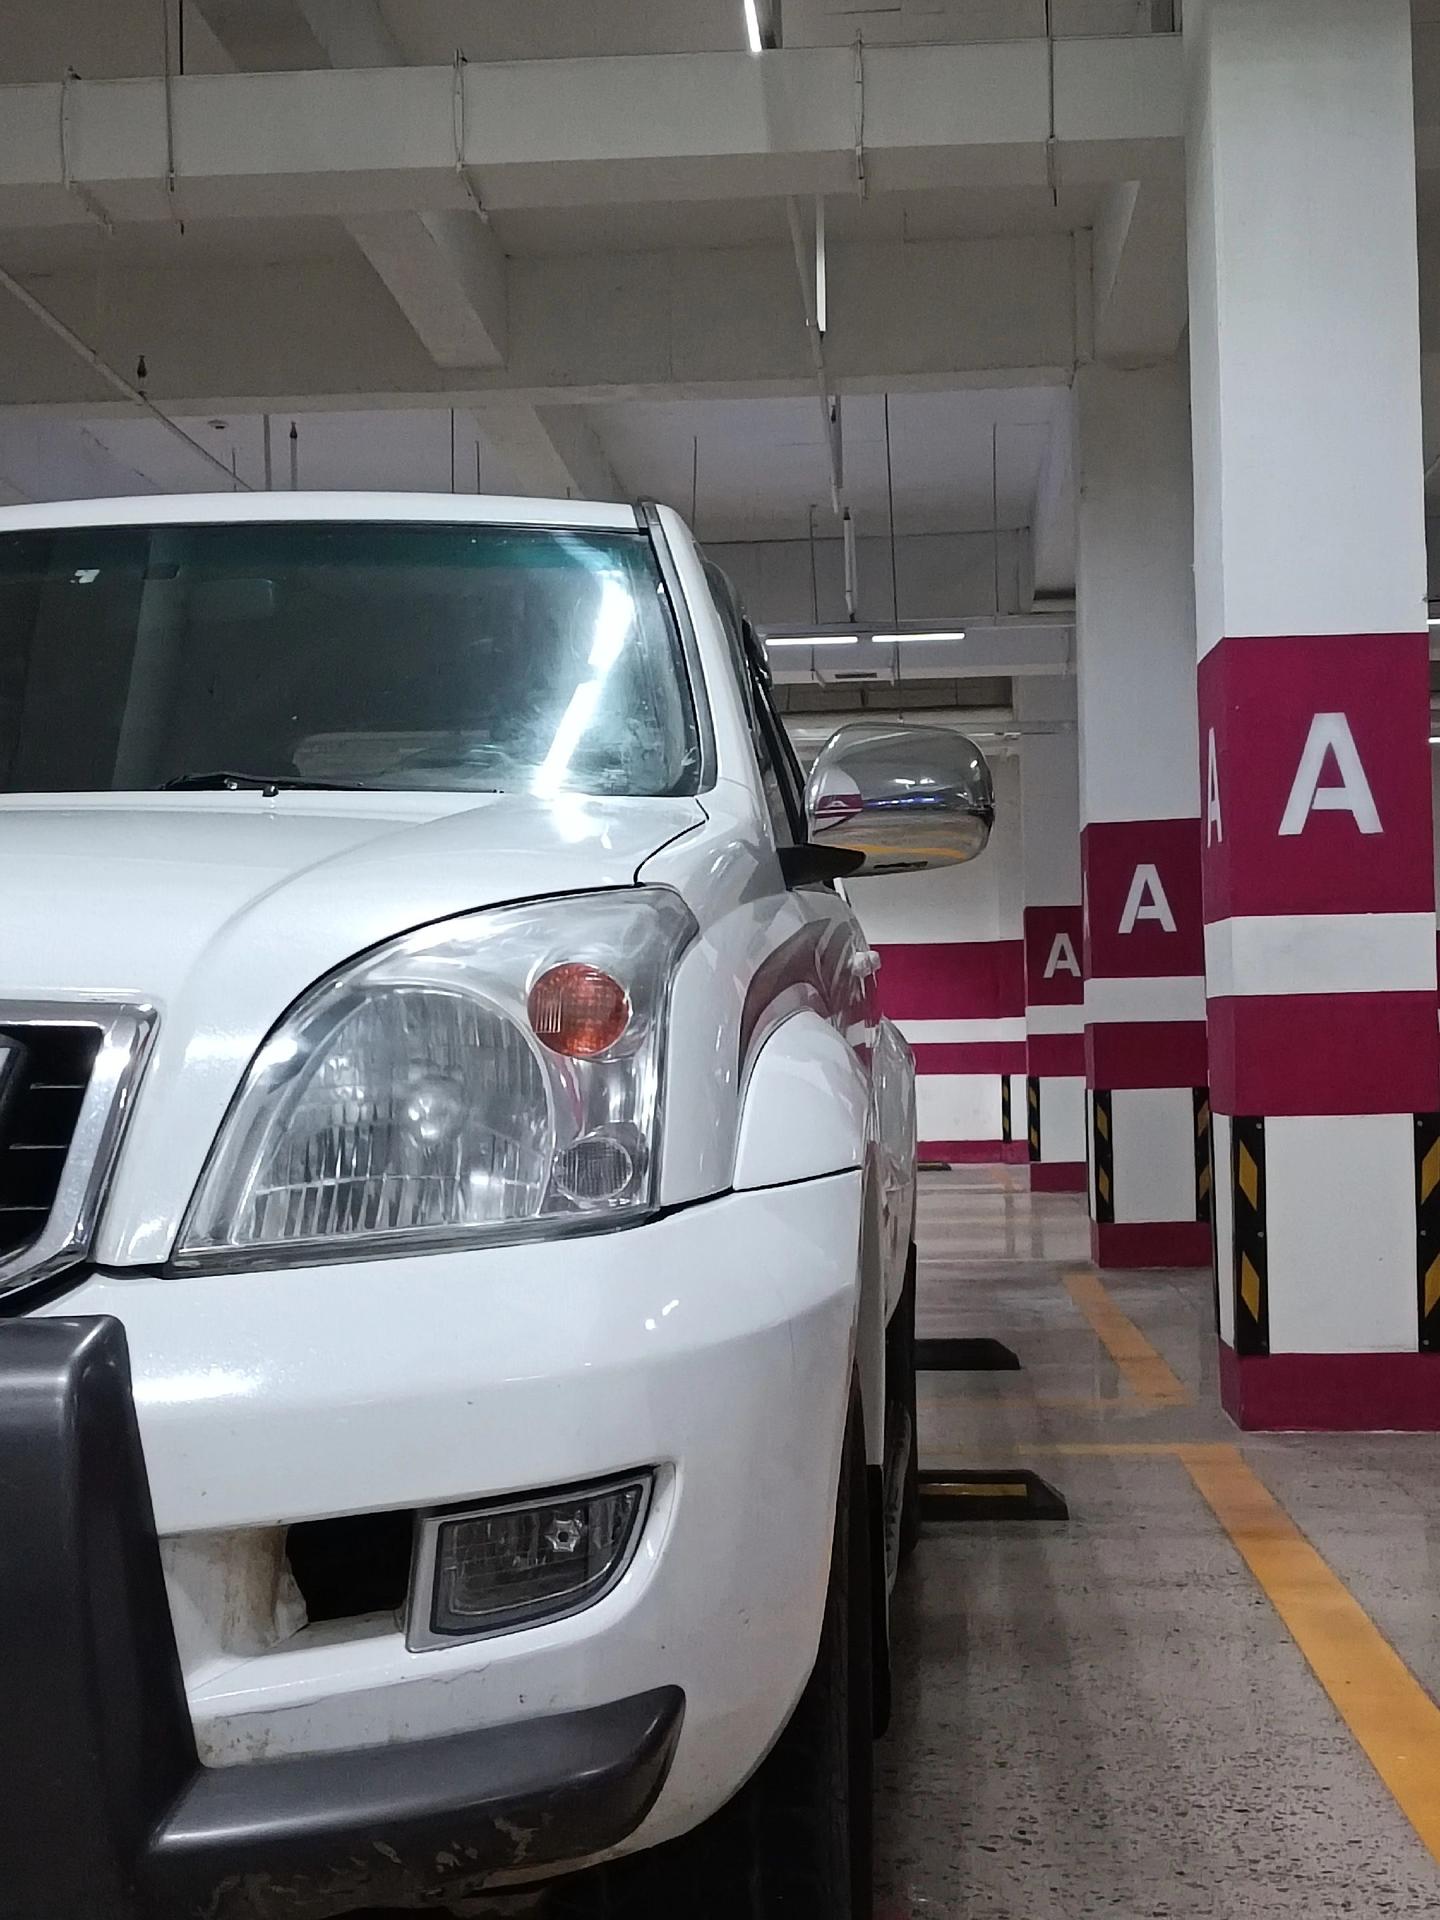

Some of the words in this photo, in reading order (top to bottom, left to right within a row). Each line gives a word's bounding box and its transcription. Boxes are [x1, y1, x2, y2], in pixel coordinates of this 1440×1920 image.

[1278, 712, 1384, 836] A
[1118, 864, 1177, 934] A
[1043, 933, 1081, 978] A
